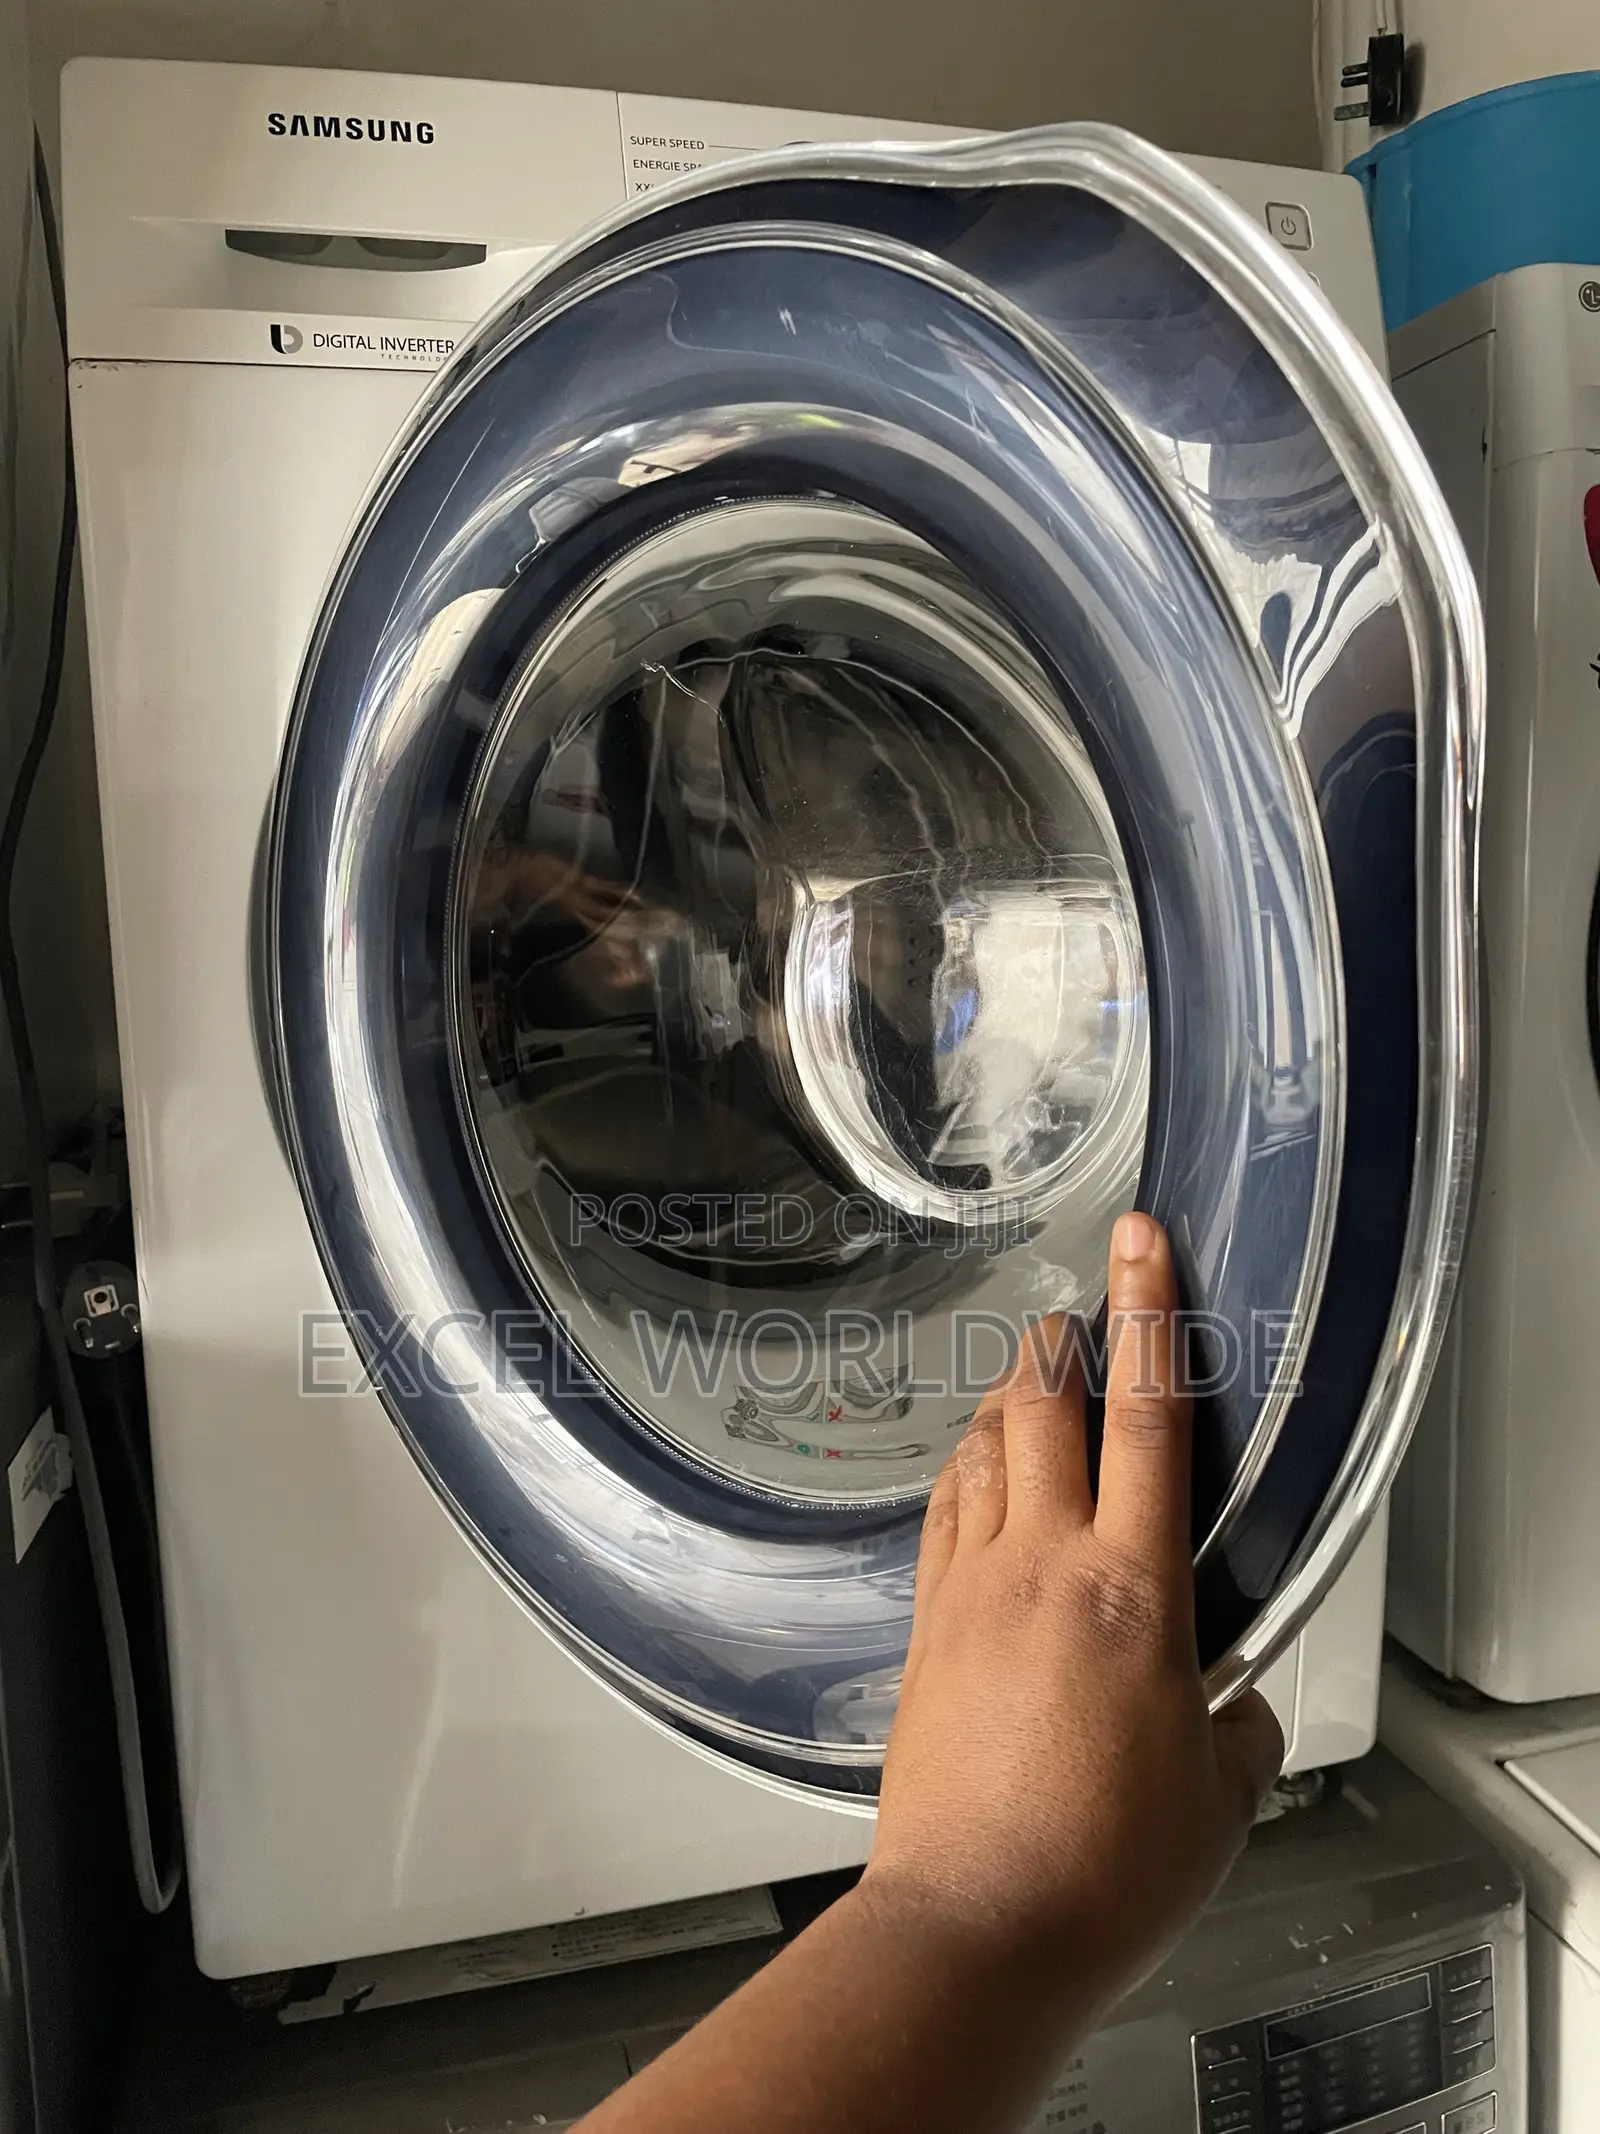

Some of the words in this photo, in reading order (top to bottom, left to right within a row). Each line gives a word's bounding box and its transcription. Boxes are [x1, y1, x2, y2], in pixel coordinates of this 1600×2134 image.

[268, 113, 434, 144] SAMSUNG
[630, 135, 666, 147] SUPER
[669, 138, 705, 150] SPEED
[633, 159, 681, 172] ENERGIE
[683, 162, 702, 171] SP
[635, 182, 654, 192] XX
[313, 333, 376, 350] DIGITAL
[380, 337, 455, 354] INVERTER
